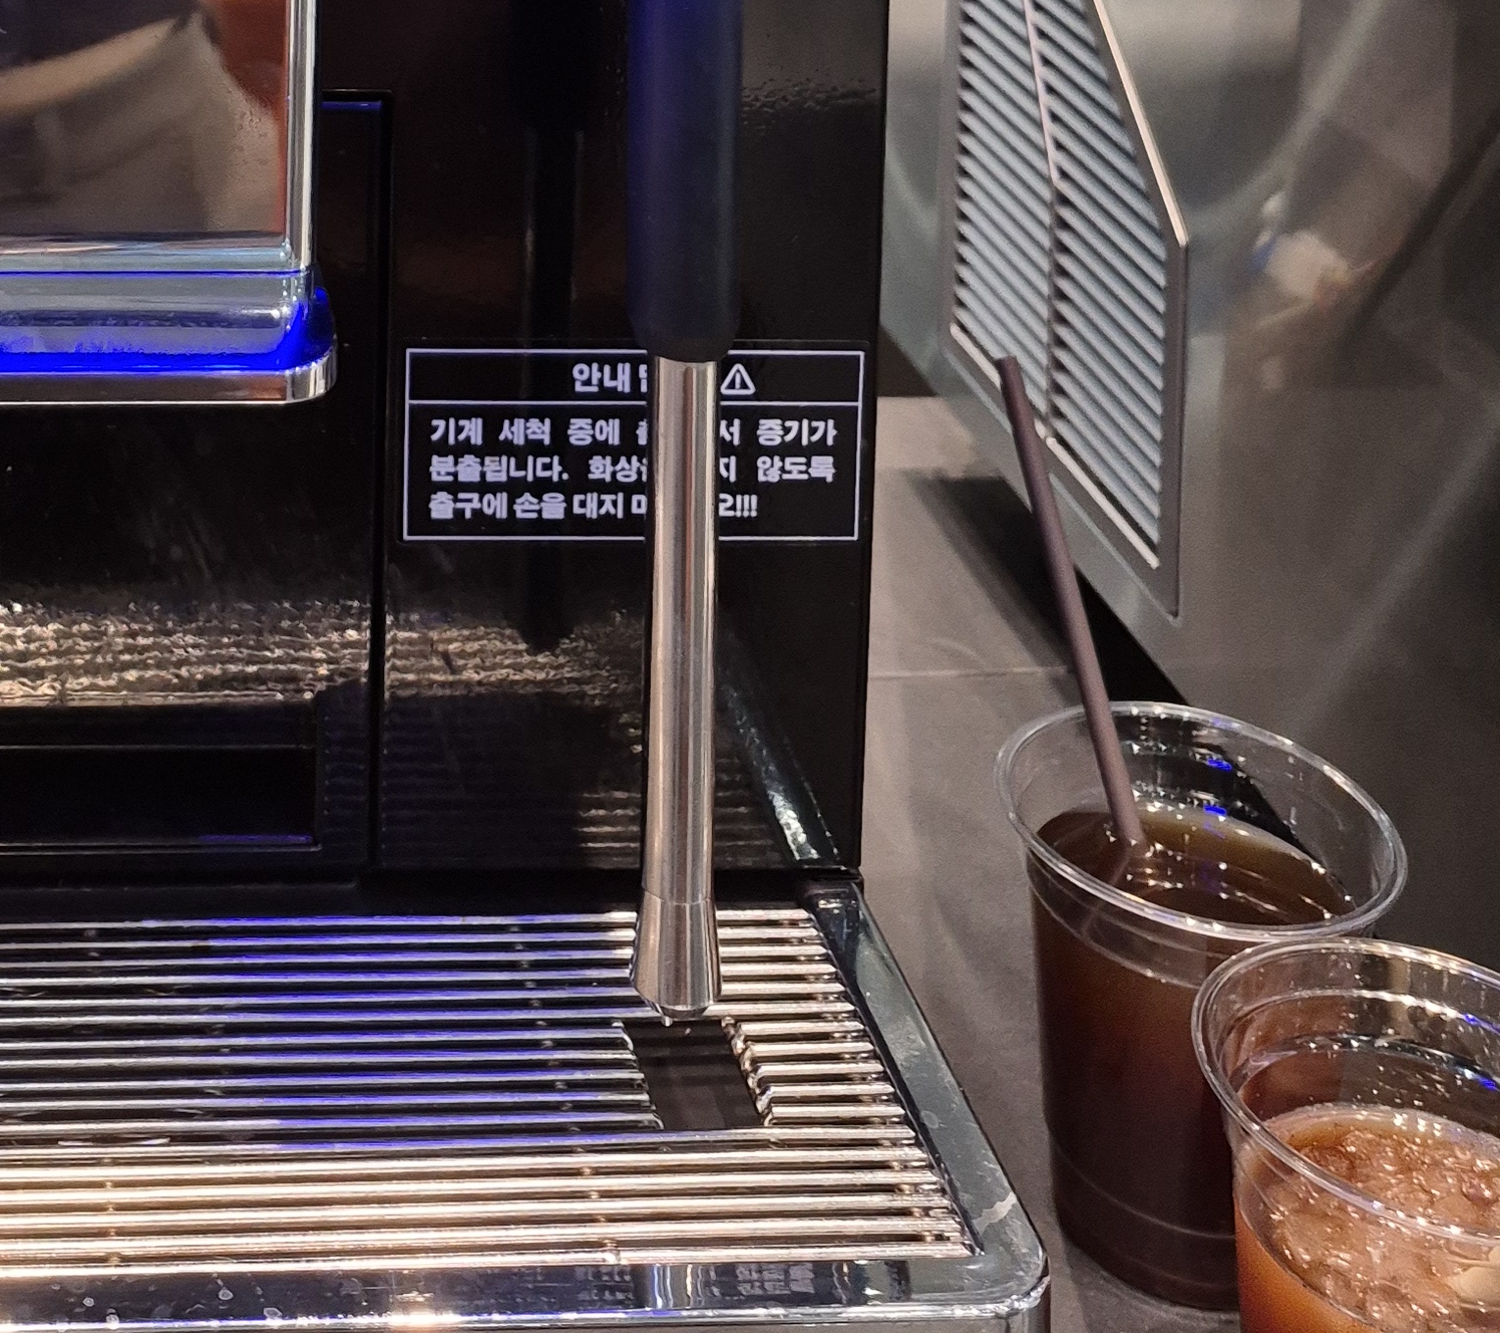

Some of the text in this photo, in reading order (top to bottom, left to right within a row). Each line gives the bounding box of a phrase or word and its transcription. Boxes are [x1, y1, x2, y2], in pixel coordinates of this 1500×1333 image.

[573, 362, 631, 393] 안내
[431, 417, 482, 446] 기계
[499, 418, 550, 446] 세척
[567, 418, 620, 446] 중에
[757, 418, 837, 446] 증기가
[429, 455, 569, 483] 분출됩니다.
[756, 455, 836, 483] 않도록
[429, 492, 507, 519] 출구에
[514, 492, 566, 519] 손을
[573, 491, 624, 518] 대지
